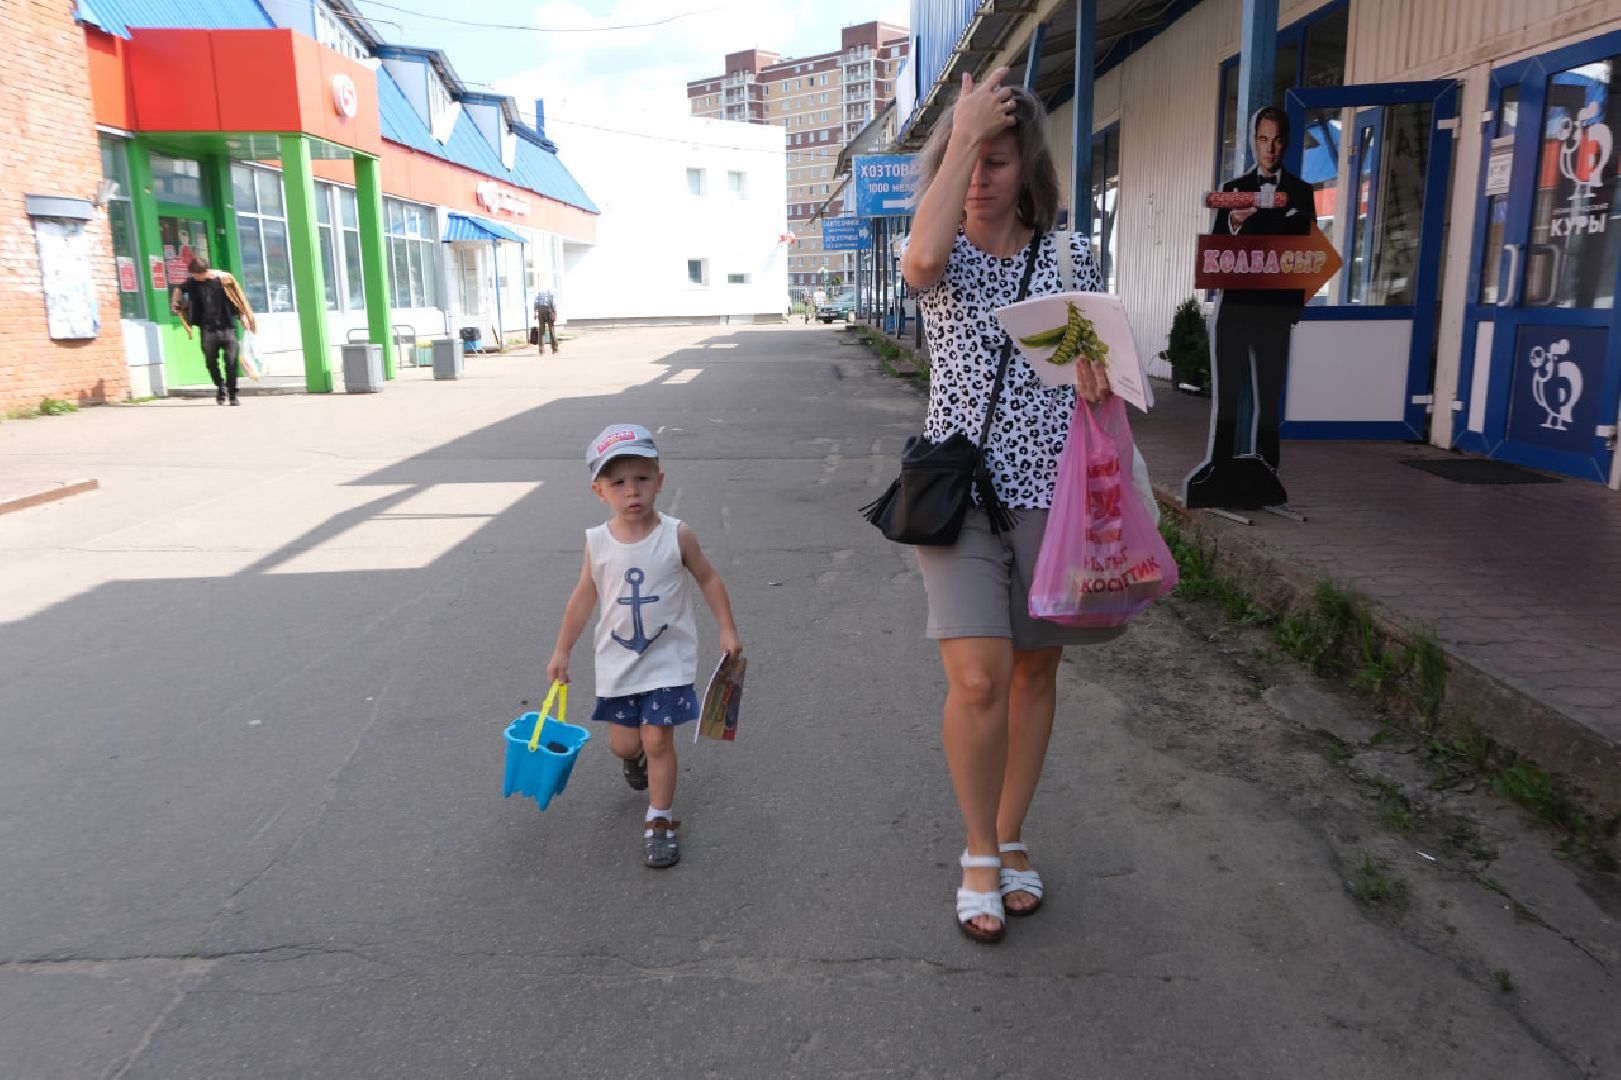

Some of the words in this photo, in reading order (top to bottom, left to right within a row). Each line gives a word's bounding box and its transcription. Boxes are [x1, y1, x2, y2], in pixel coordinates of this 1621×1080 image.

[860, 163, 921, 178] ХОЗТОВА
[869, 183, 890, 193] 1000
[1550, 213, 1607, 236] КУРЫ
[1203, 249, 1327, 274] КОЛБАСЫР
